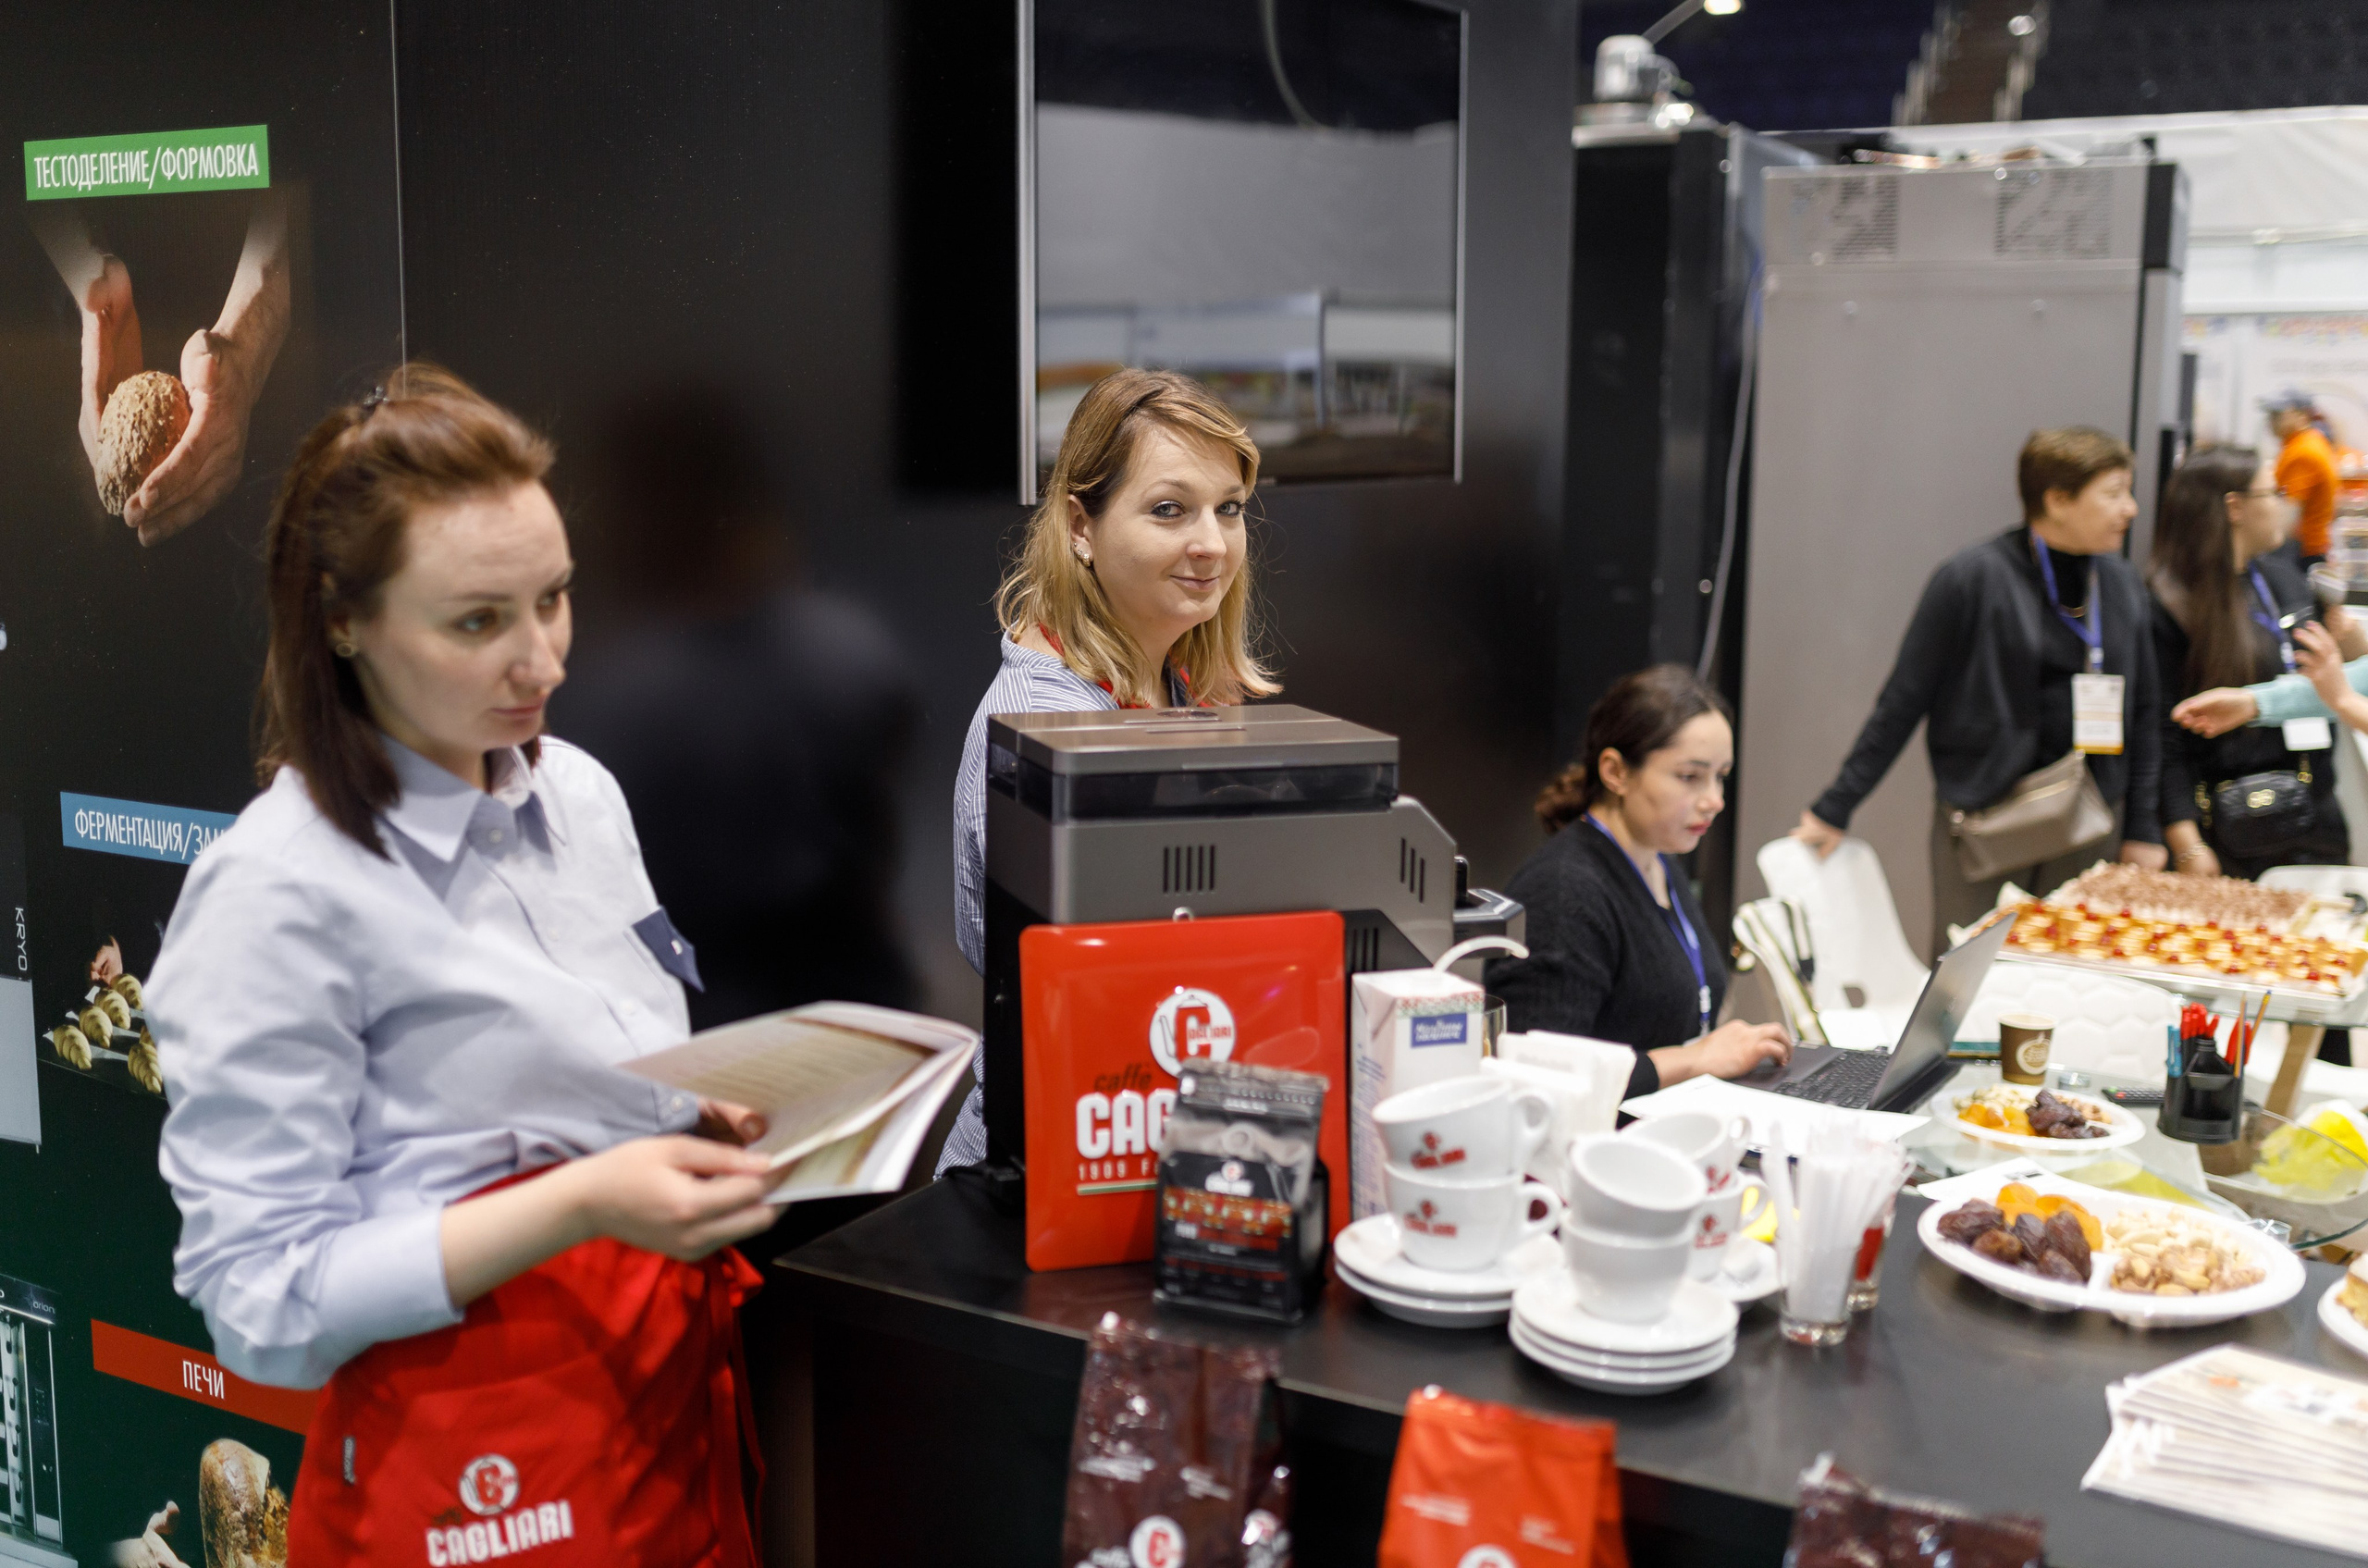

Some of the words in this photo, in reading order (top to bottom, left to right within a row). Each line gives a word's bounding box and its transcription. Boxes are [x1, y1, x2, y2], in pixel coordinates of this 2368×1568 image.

[34, 143, 259, 191] ТЕСТОДЕЛЕНИЕ/ФОРМОВКА
[15, 907, 28, 971] KRYO
[1076, 1088, 1178, 1160] CAG
[182, 1360, 225, 1400] ПЕЧИ
[426, 1498, 575, 1568] CAGLIARI
